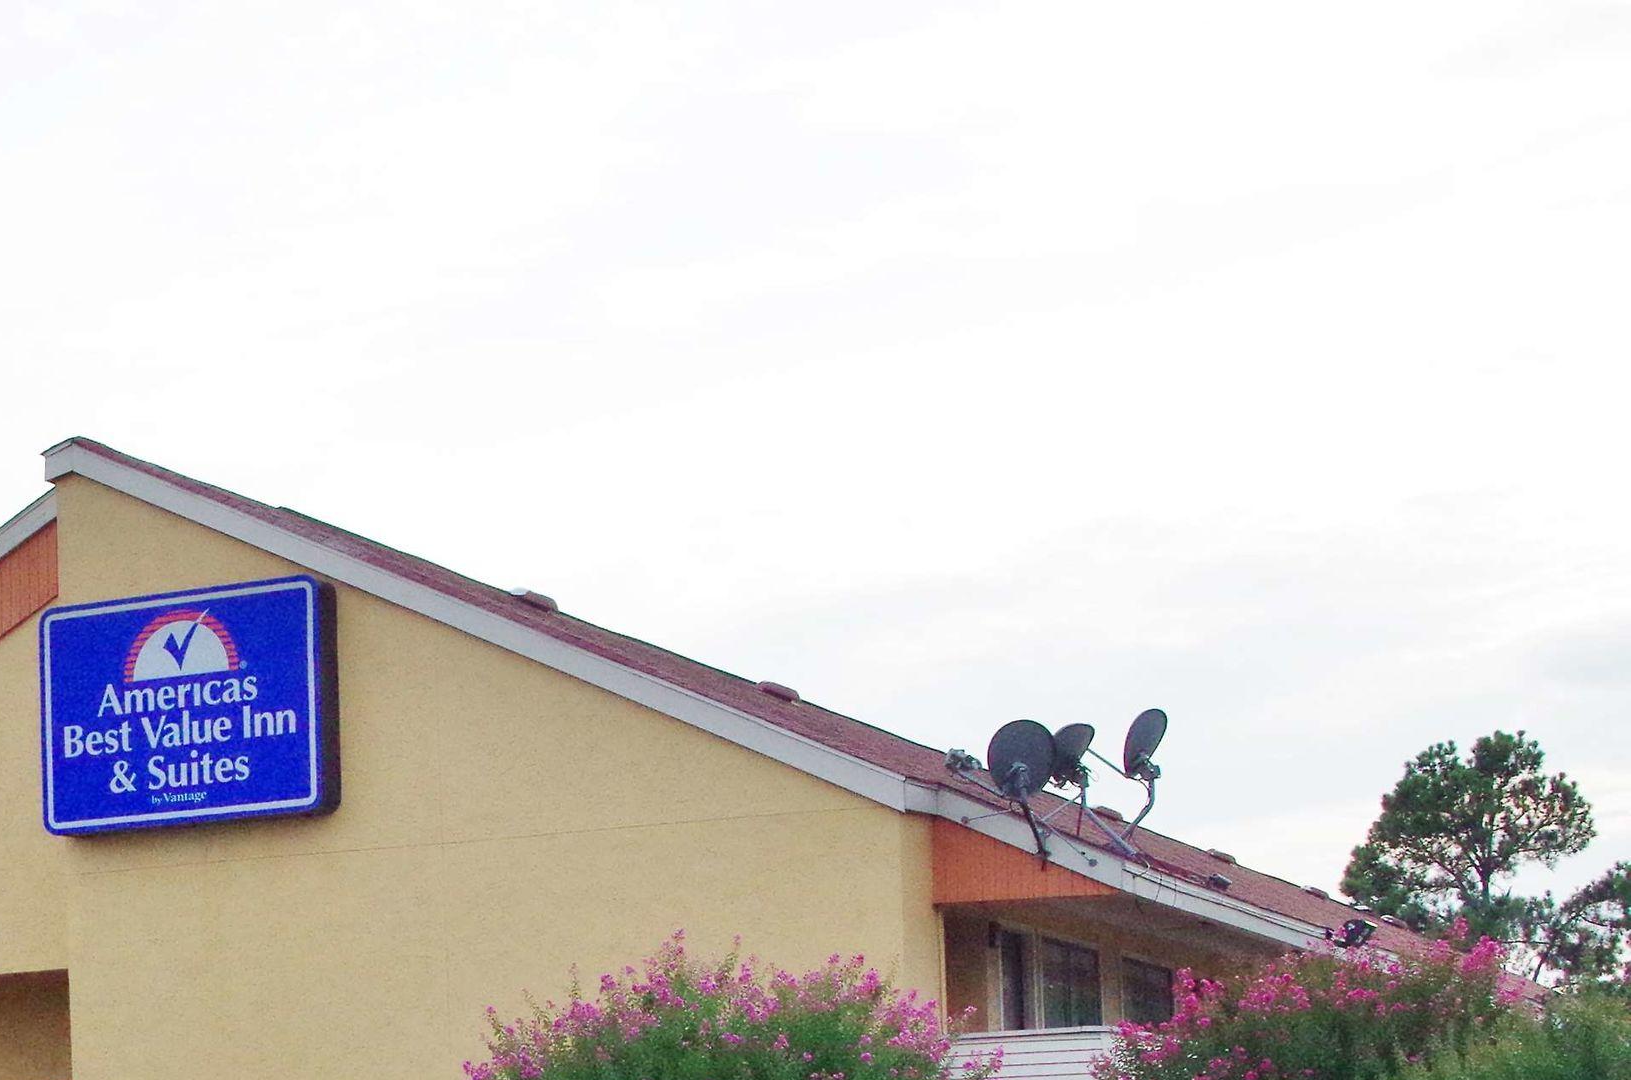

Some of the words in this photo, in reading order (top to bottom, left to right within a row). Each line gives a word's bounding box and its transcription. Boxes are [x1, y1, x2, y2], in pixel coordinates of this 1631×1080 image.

[97, 676, 258, 717] Americas
[63, 721, 132, 758] Best
[142, 710, 232, 749] Value
[242, 706, 296, 738] Inn
[109, 760, 137, 793] &
[148, 750, 250, 790] Suites
[151, 794, 163, 805] by
[163, 791, 207, 804] Vantage
